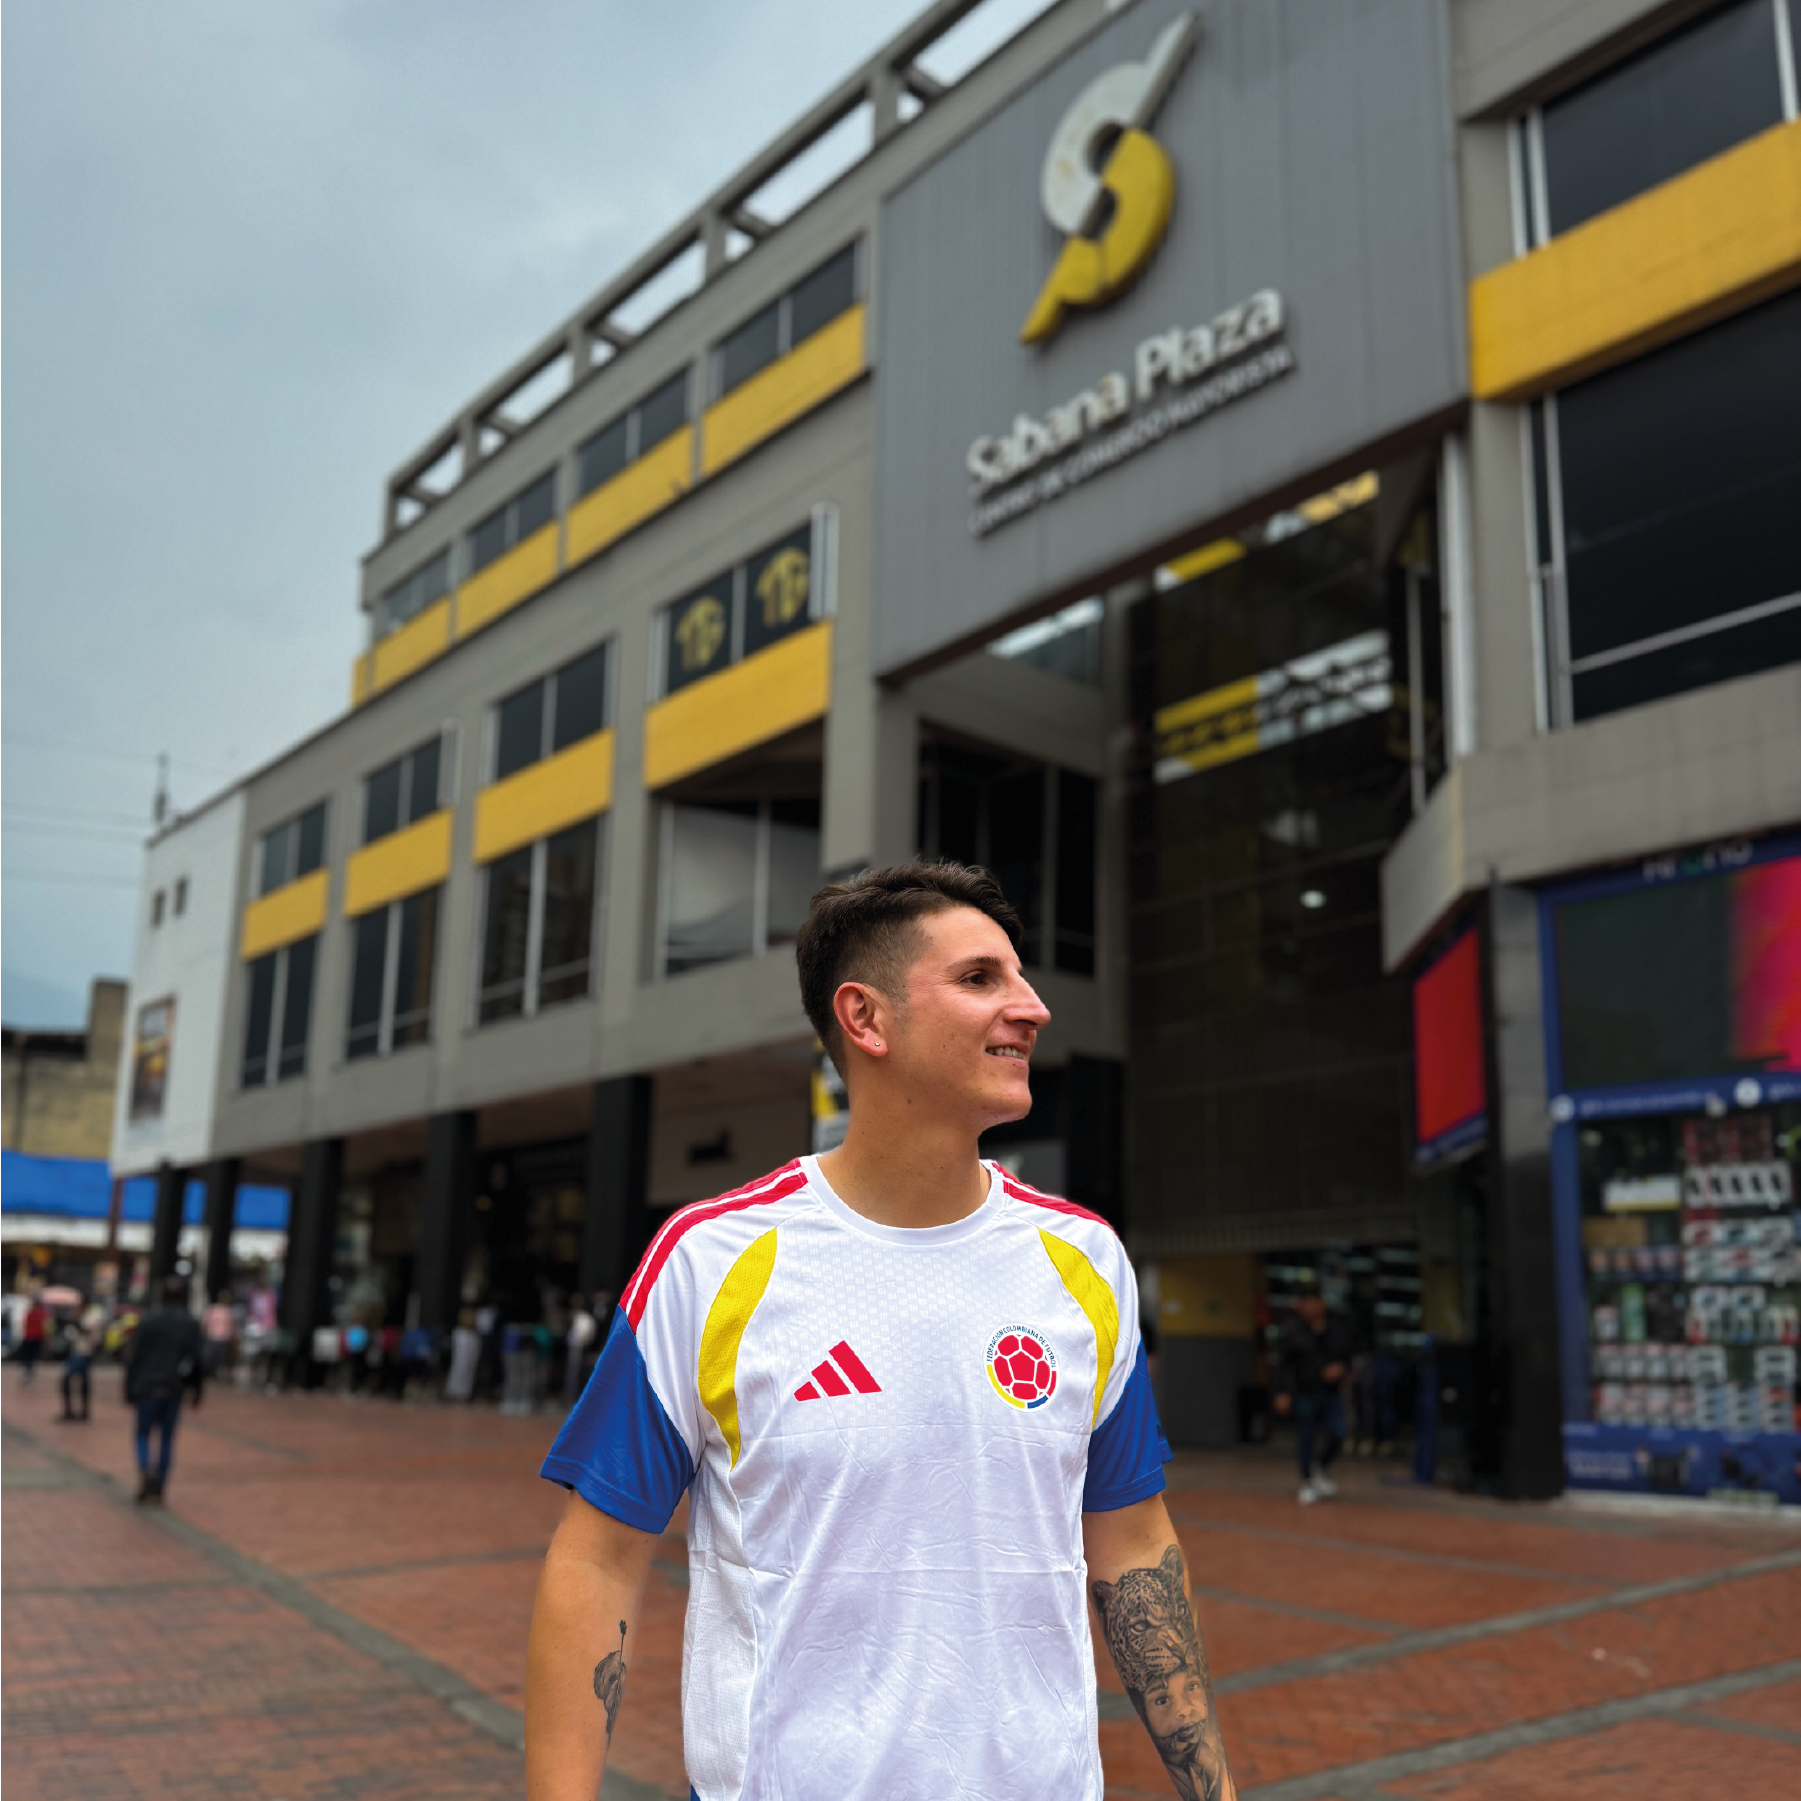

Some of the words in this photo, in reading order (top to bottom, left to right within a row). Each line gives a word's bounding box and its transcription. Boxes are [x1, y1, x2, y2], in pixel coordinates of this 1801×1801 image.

[965, 371, 1129, 496] Sabana
[1135, 287, 1283, 400] Plaza
[1003, 1325, 1039, 1339] COLOMBIANA
[1038, 1336, 1047, 1346] DE
